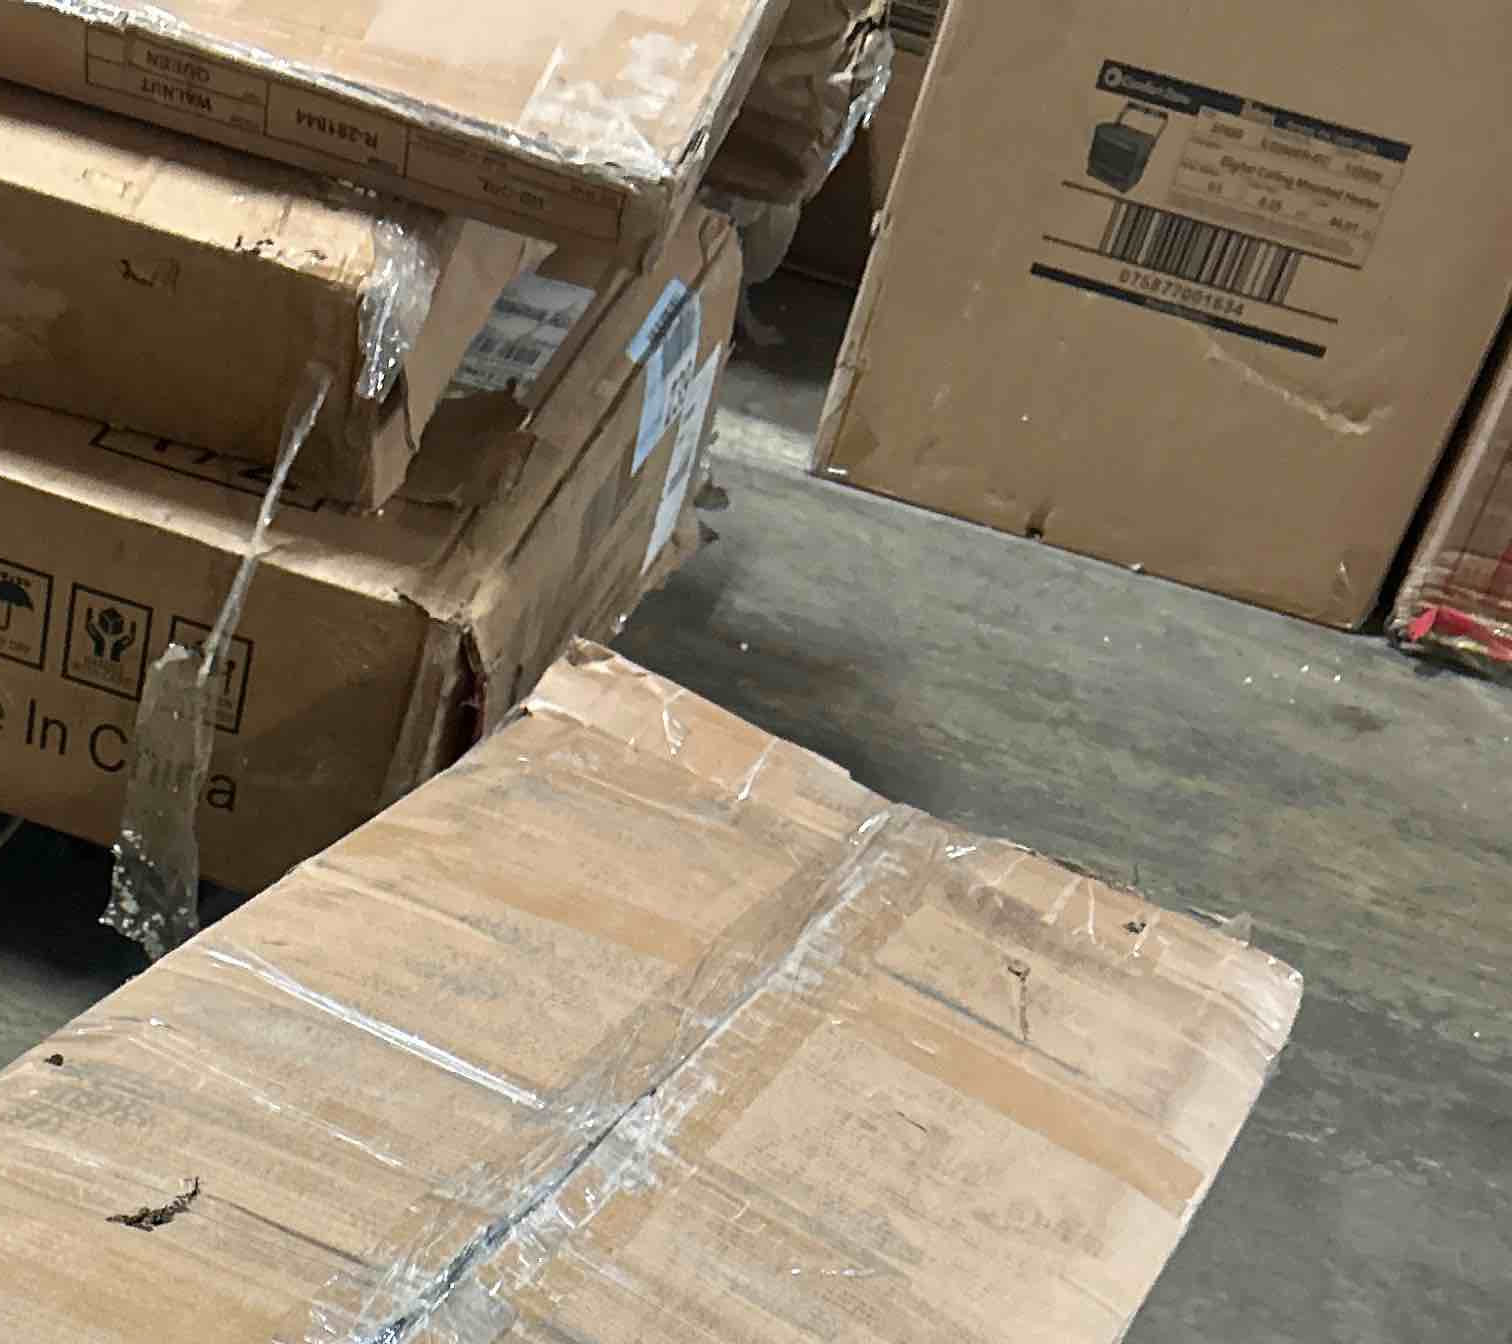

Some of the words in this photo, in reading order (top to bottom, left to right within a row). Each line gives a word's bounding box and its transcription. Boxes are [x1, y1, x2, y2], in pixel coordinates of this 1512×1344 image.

[140, 77, 213, 112] WALNUT
[24, 697, 69, 756] In
[88, 723, 237, 813] Cia
